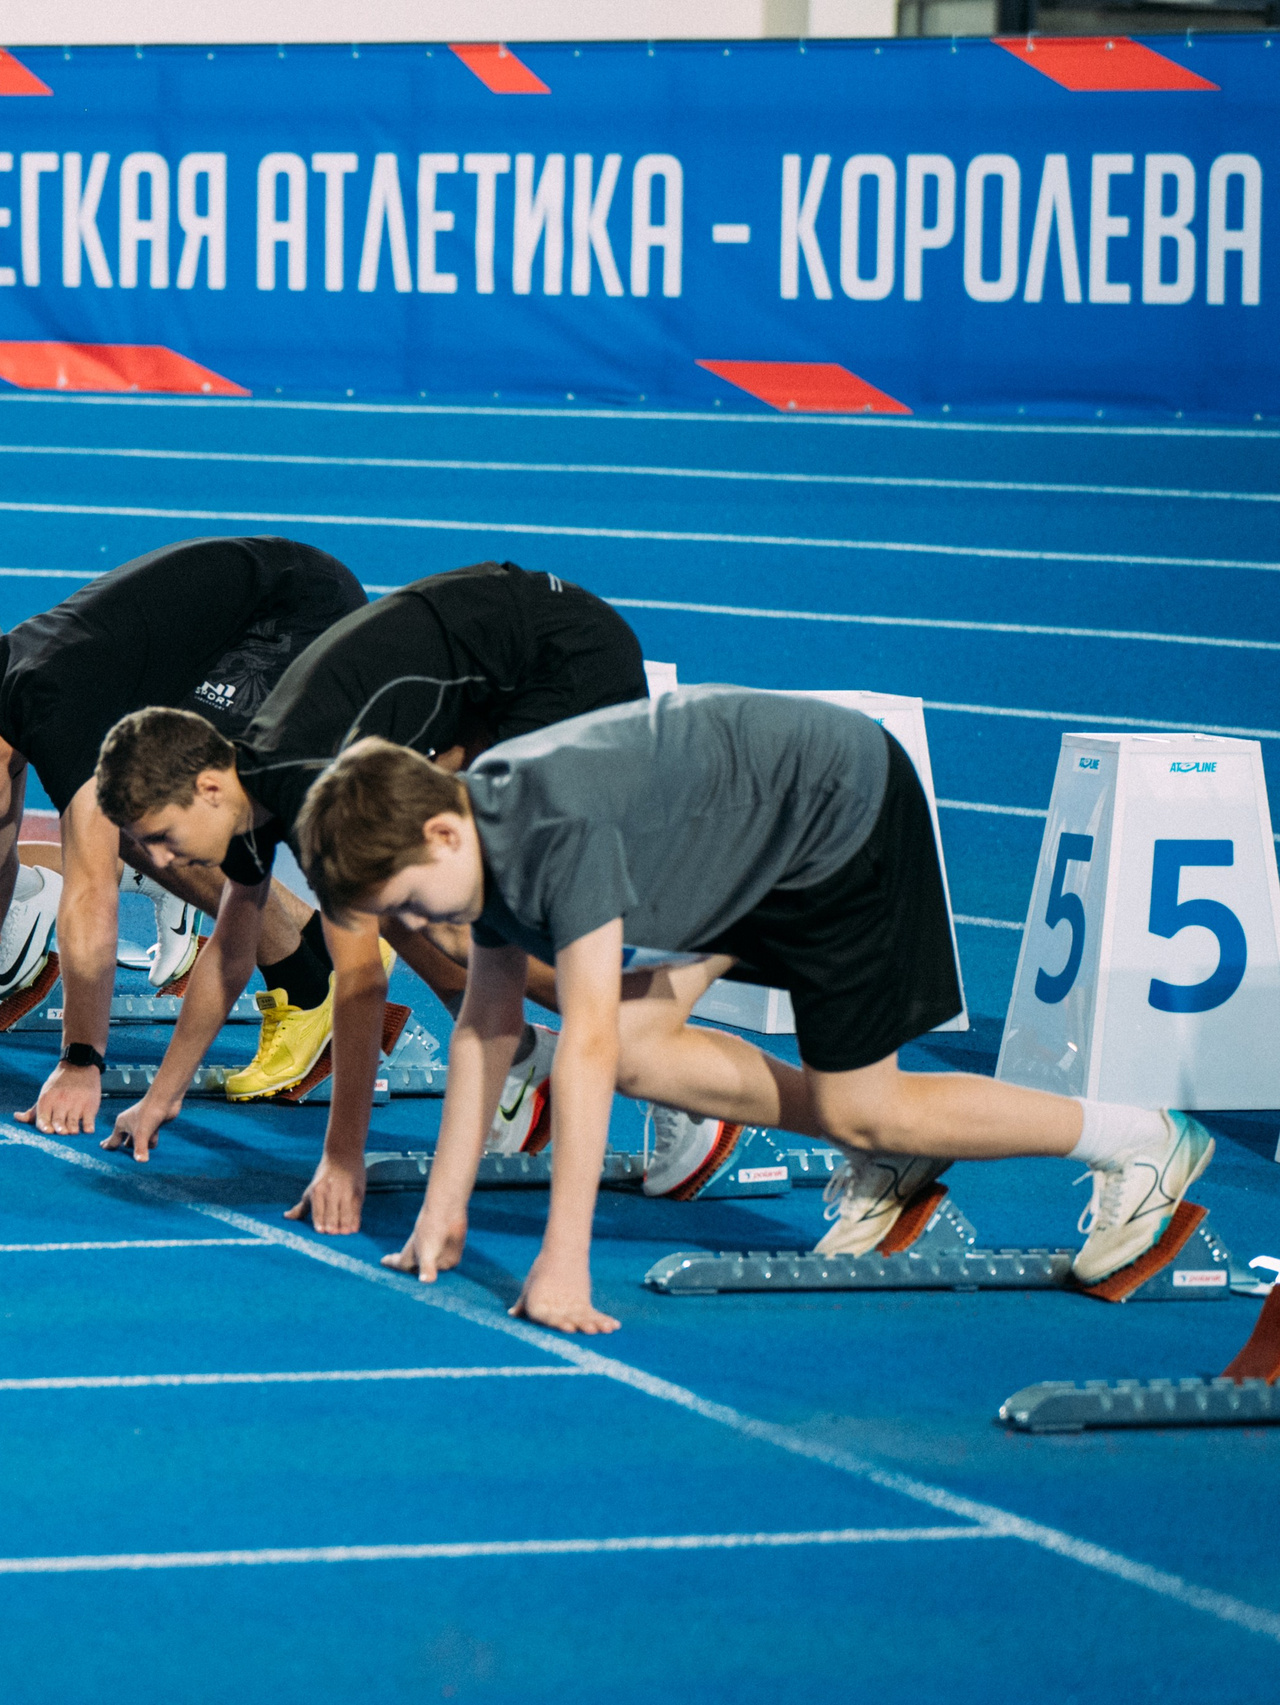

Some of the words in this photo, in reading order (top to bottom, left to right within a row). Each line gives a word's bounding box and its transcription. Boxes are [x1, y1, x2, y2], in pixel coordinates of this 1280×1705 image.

[256, 153, 684, 297] АТЛЕТИКА
[780, 153, 1262, 305] КОРОЛЕВА
[1035, 832, 1094, 1005] 5
[1147, 838, 1248, 1014] 5
